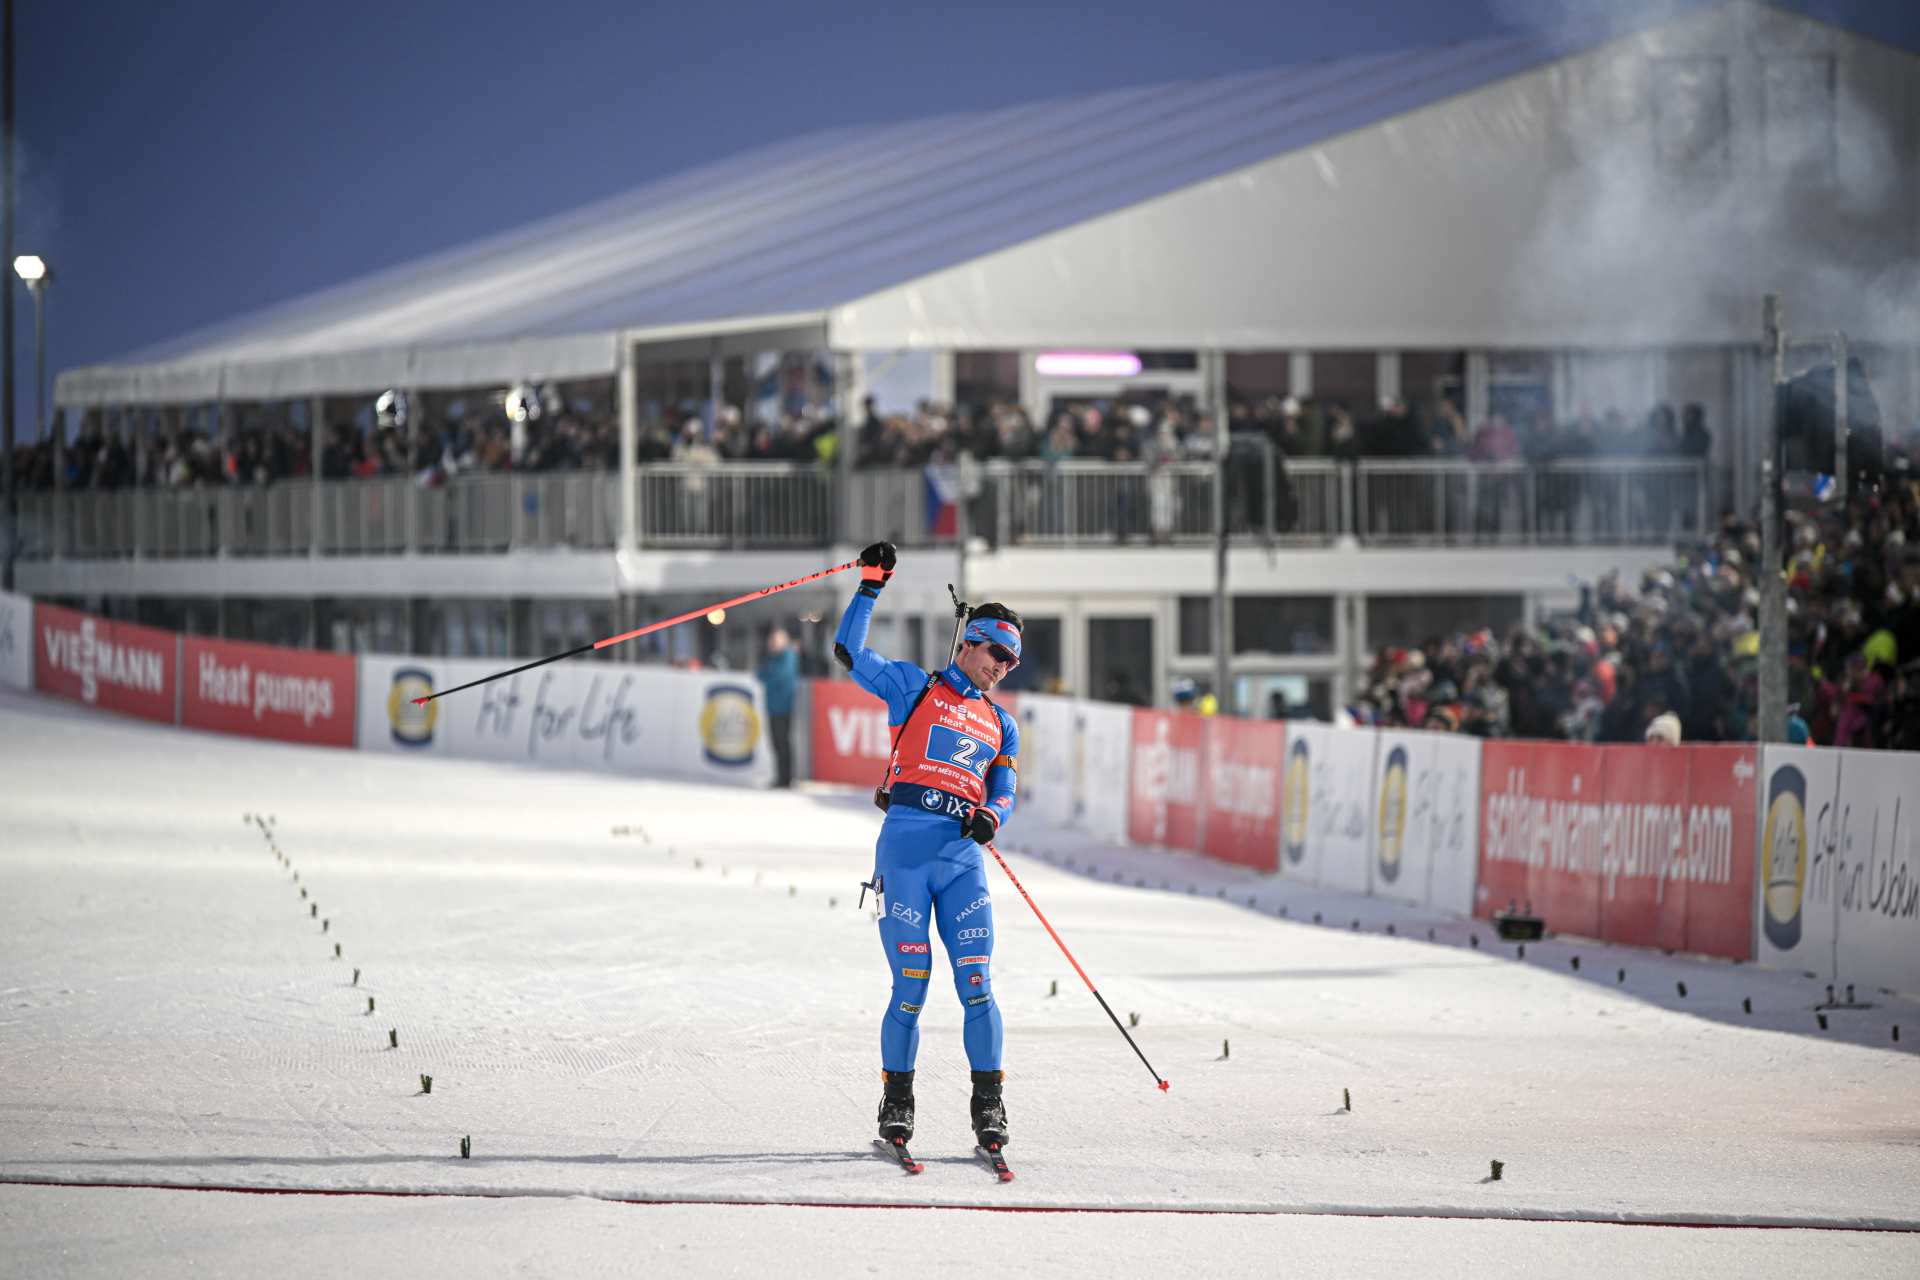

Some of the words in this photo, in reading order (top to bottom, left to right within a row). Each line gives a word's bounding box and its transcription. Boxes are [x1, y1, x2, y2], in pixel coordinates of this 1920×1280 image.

[44, 618, 164, 702] VIESSMANN
[198, 655, 251, 706] Heat
[254, 669, 333, 727] pumps
[933, 697, 1001, 736] VIESSMANN
[939, 714, 963, 731] Heat
[965, 724, 996, 745] pumps
[951, 736, 979, 768] 2
[891, 901, 923, 926] EA7
[955, 896, 992, 923] FALCON
[901, 944, 928, 953] enel
